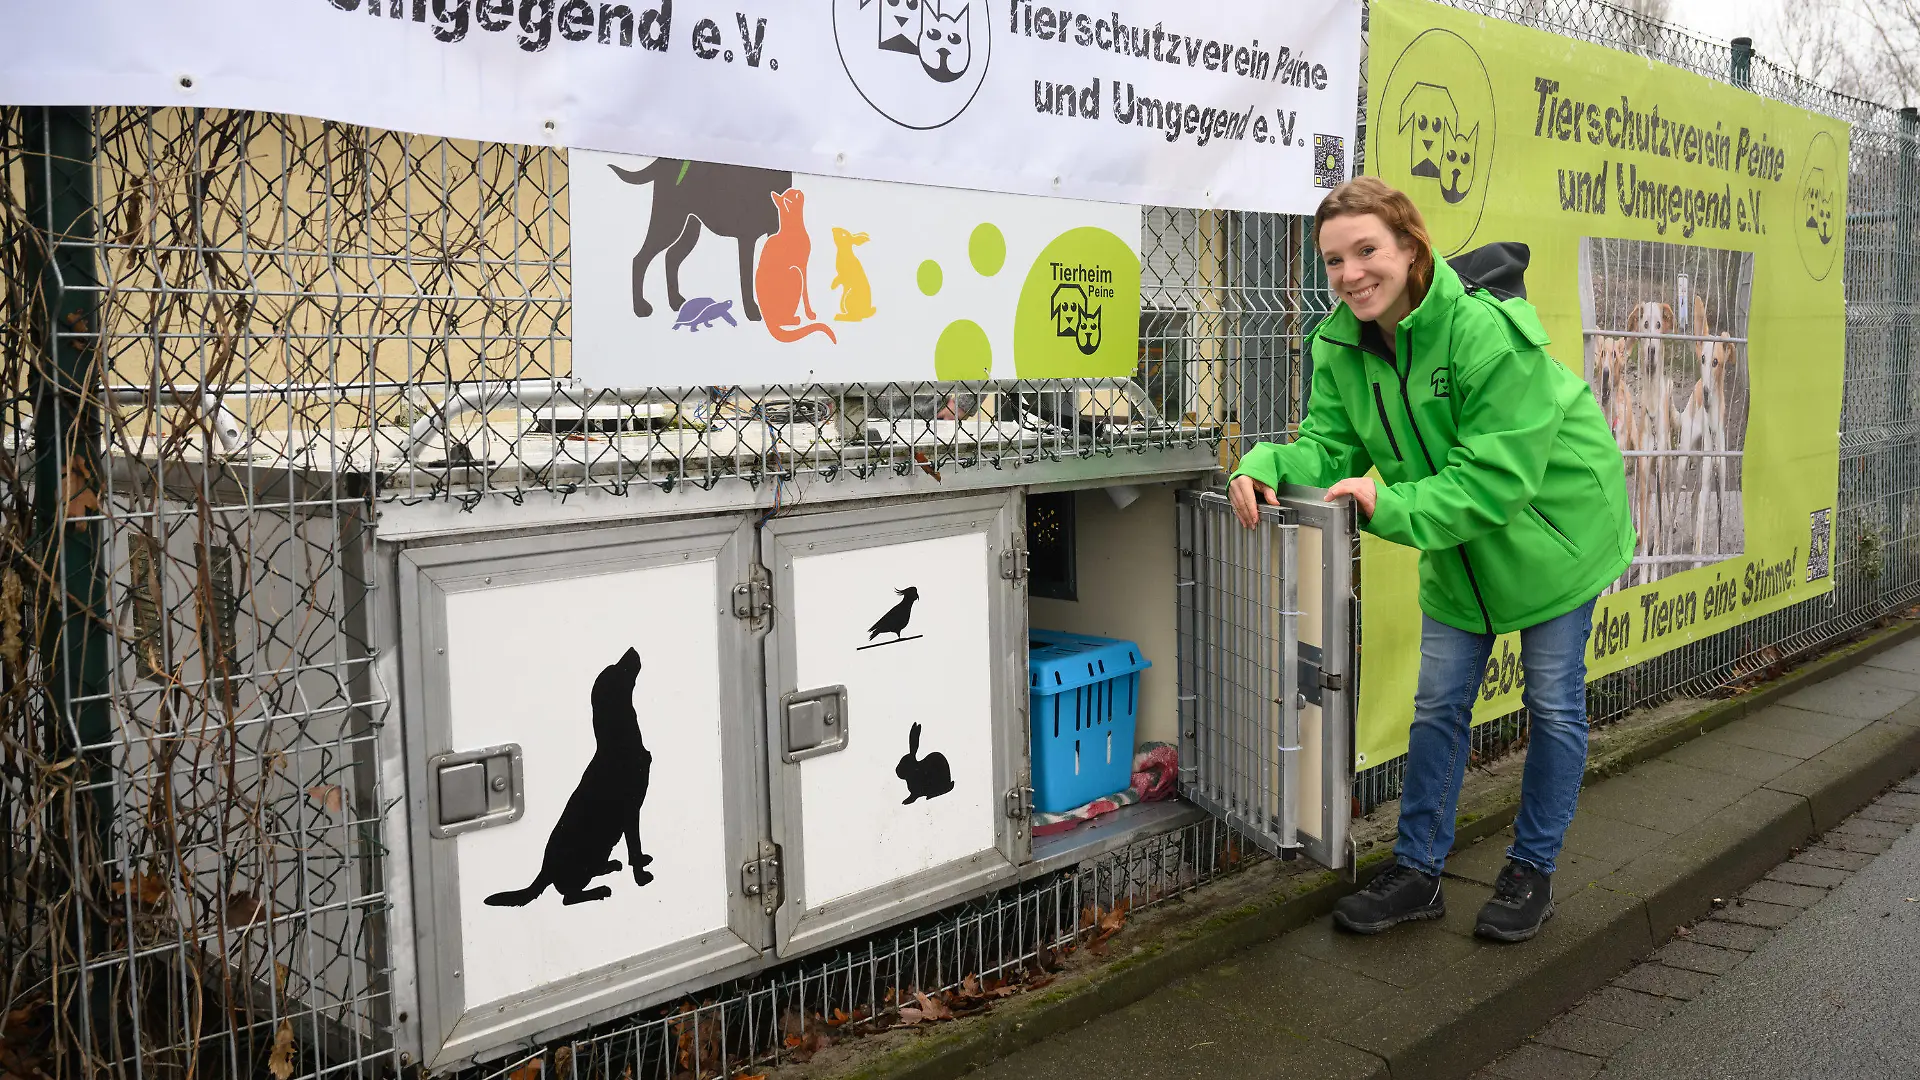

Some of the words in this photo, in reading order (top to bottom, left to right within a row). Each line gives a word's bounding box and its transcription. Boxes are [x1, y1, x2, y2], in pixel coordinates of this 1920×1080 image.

[327, 0, 671, 52] gegend
[691, 12, 779, 72] e.V.
[1010, 0, 1269, 81] Tierschutzverein
[1271, 45, 1328, 90] Peine
[1034, 77, 1101, 120] und
[1113, 80, 1255, 147] Umgegend
[1252, 108, 1305, 148] e.V.
[1533, 76, 1731, 171] Tierschutzverein
[1735, 127, 1786, 183] Peine
[1557, 160, 1609, 215] und
[1616, 162, 1731, 239] Umgegend
[1736, 188, 1767, 236] e.V.
[1050, 262, 1112, 283] Tierheim
[1088, 284, 1114, 298] Peine
[1594, 607, 1630, 659] den
[1640, 590, 1697, 643] Tieren
[1703, 572, 1738, 621] eine
[1741, 547, 1797, 606] Stimme!
